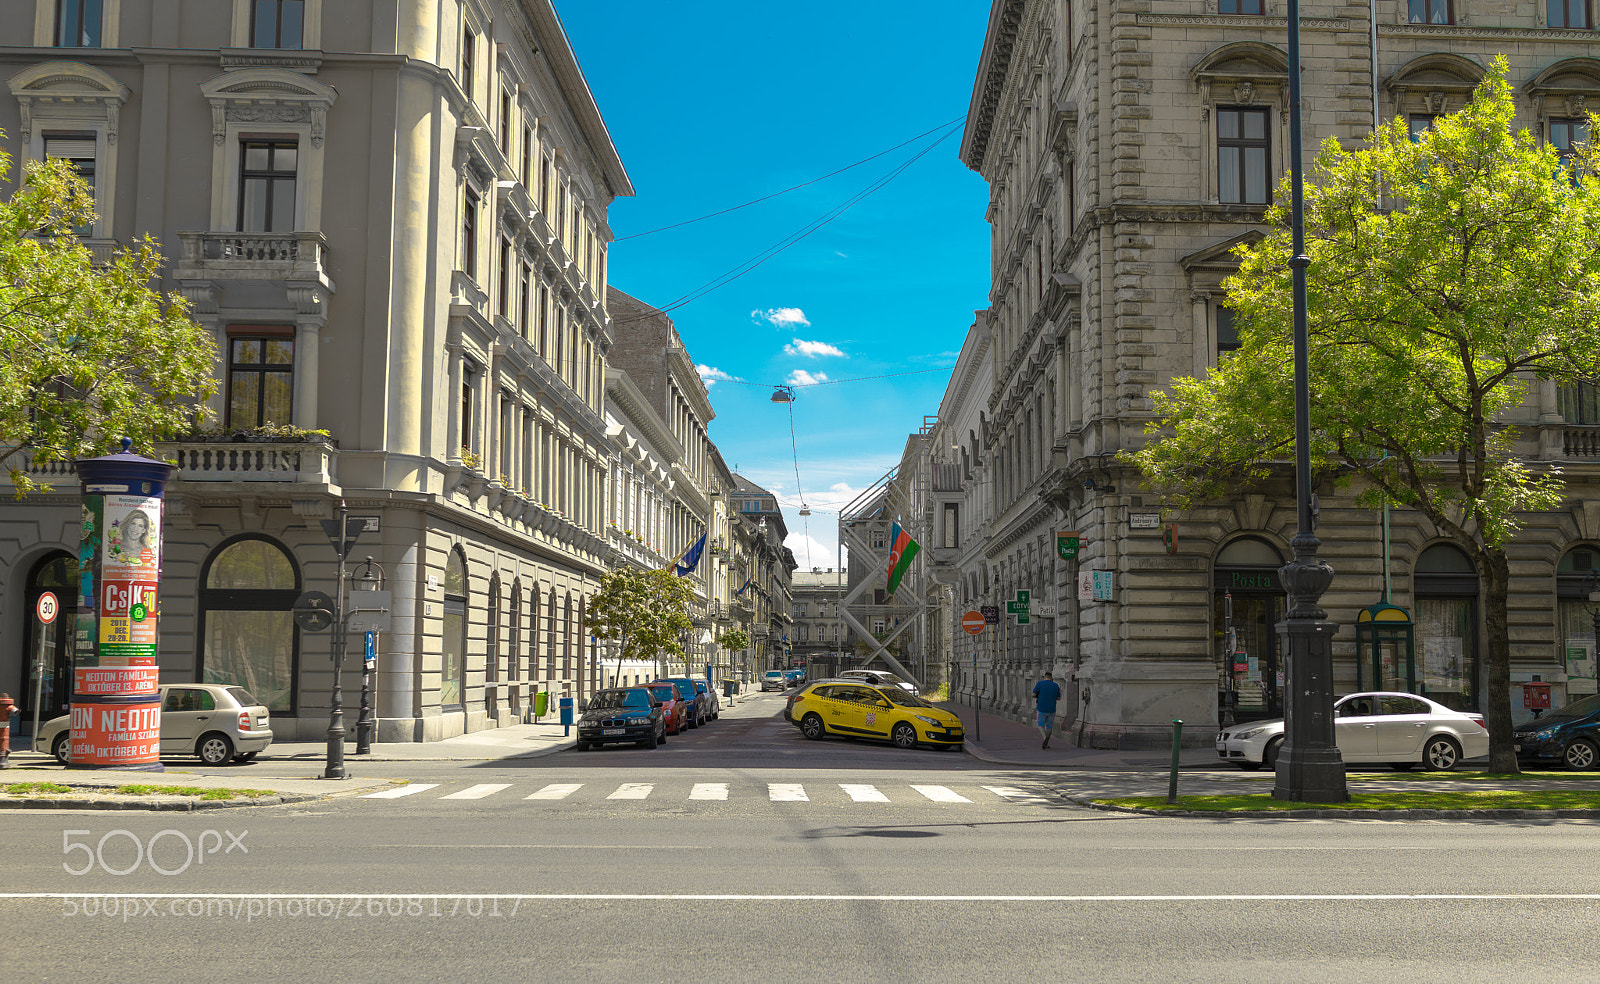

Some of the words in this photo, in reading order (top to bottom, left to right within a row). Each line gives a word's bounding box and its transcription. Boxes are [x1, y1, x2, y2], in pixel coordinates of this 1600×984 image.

[1231, 572, 1271, 588] Posta
[43, 601, 53, 614] 30
[143, 591, 156, 612] 30
[85, 672, 116, 682] NEOTON
[118, 669, 148, 681] FAMÍLIA
[87, 682, 121, 692] OKTÓBER
[123, 682, 133, 691] 13.
[135, 680, 154, 690] ARÉNA
[108, 731, 137, 742] FAMÍLIA
[96, 745, 137, 758] OKTÓBER
[139, 744, 149, 755] 13.
